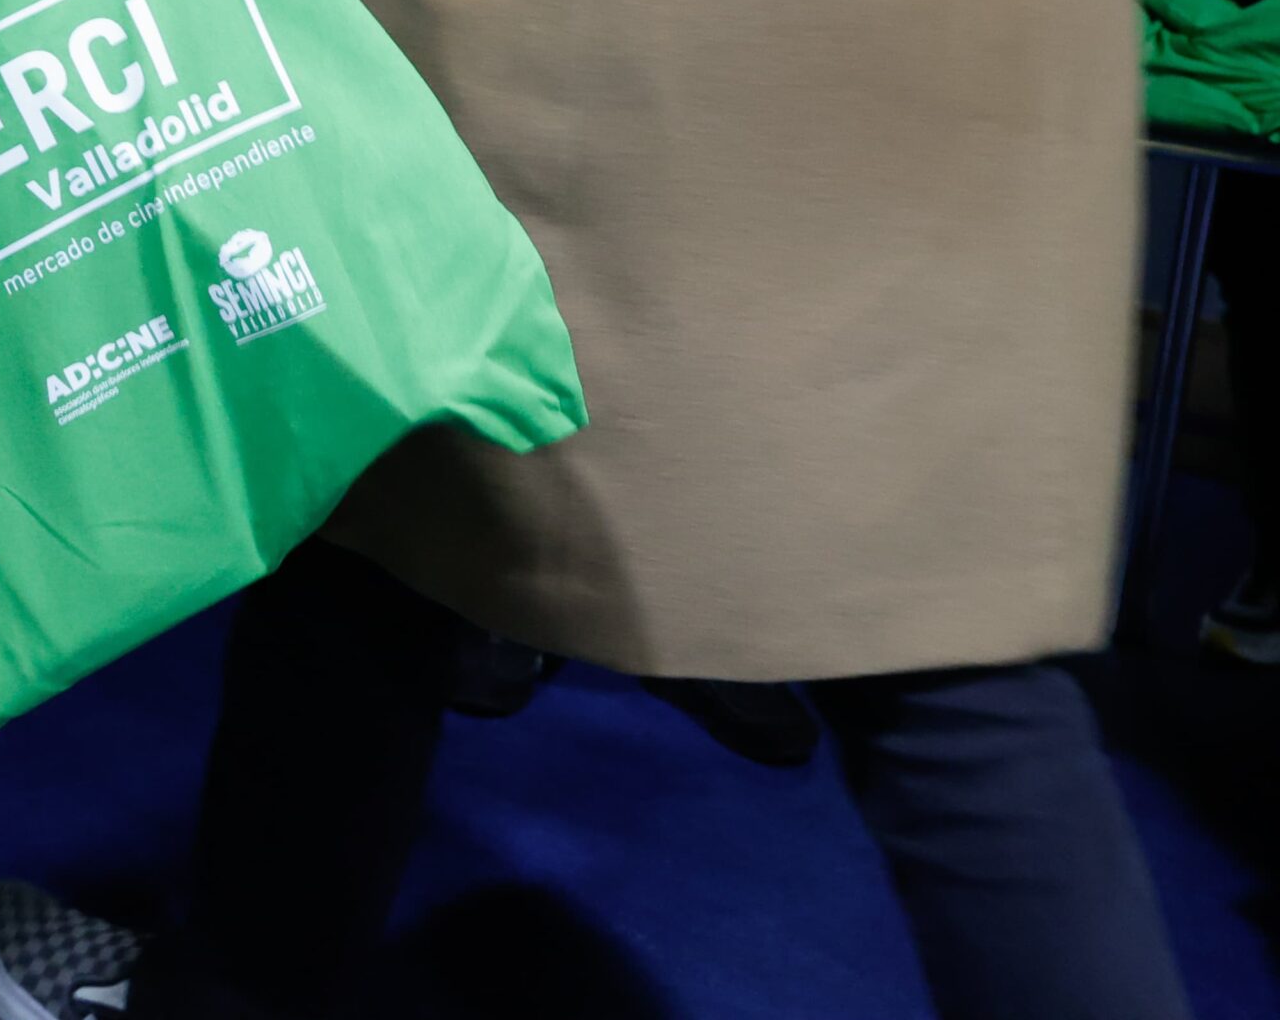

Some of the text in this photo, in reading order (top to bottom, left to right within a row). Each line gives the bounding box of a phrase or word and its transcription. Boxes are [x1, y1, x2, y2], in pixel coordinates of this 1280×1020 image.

[25, 80, 241, 210] Valladolid
[3, 125, 317, 296] mercado de cine independiente
[207, 246, 317, 324] SEMINCI
